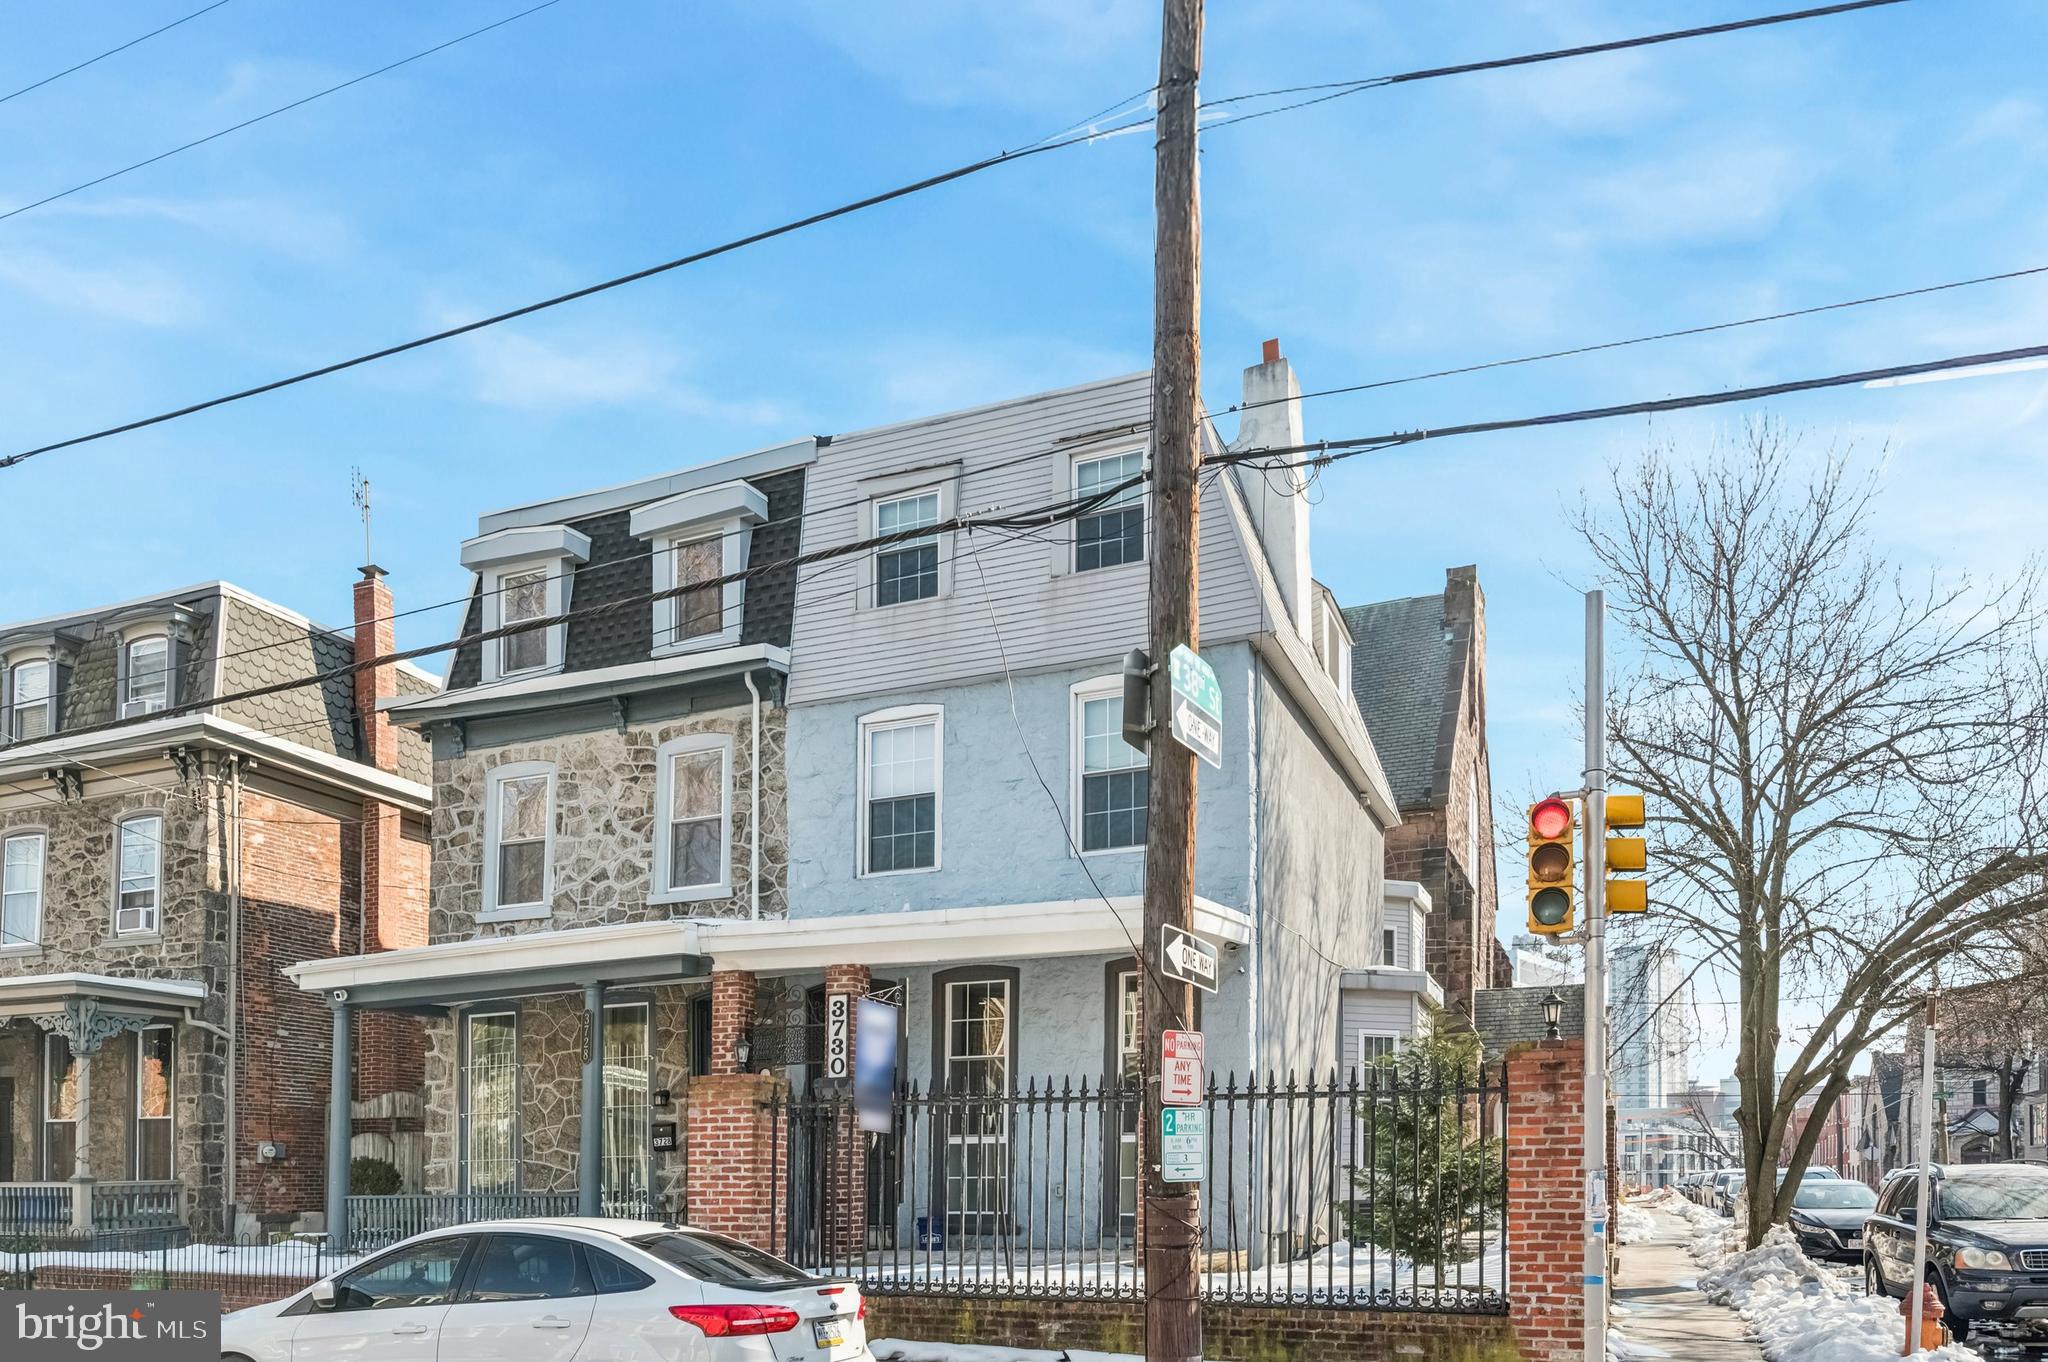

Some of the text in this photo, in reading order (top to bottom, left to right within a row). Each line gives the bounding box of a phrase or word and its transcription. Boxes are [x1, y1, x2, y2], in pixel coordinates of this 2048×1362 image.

[1183, 947, 1213, 976] ONE WAY
[830, 1000, 845, 1075] 3730
[1165, 1038, 1201, 1052] NO PARKING
[1174, 1061, 1191, 1071] ANY
[1173, 1074, 1192, 1085] TIME
[1165, 1112, 1195, 1132] 2 HR
[1176, 1123, 1203, 1133] PARKING
[654, 1137, 672, 1146] 3728
[1185, 1136, 1191, 1145] 6
[1183, 1153, 1188, 1163] 3
